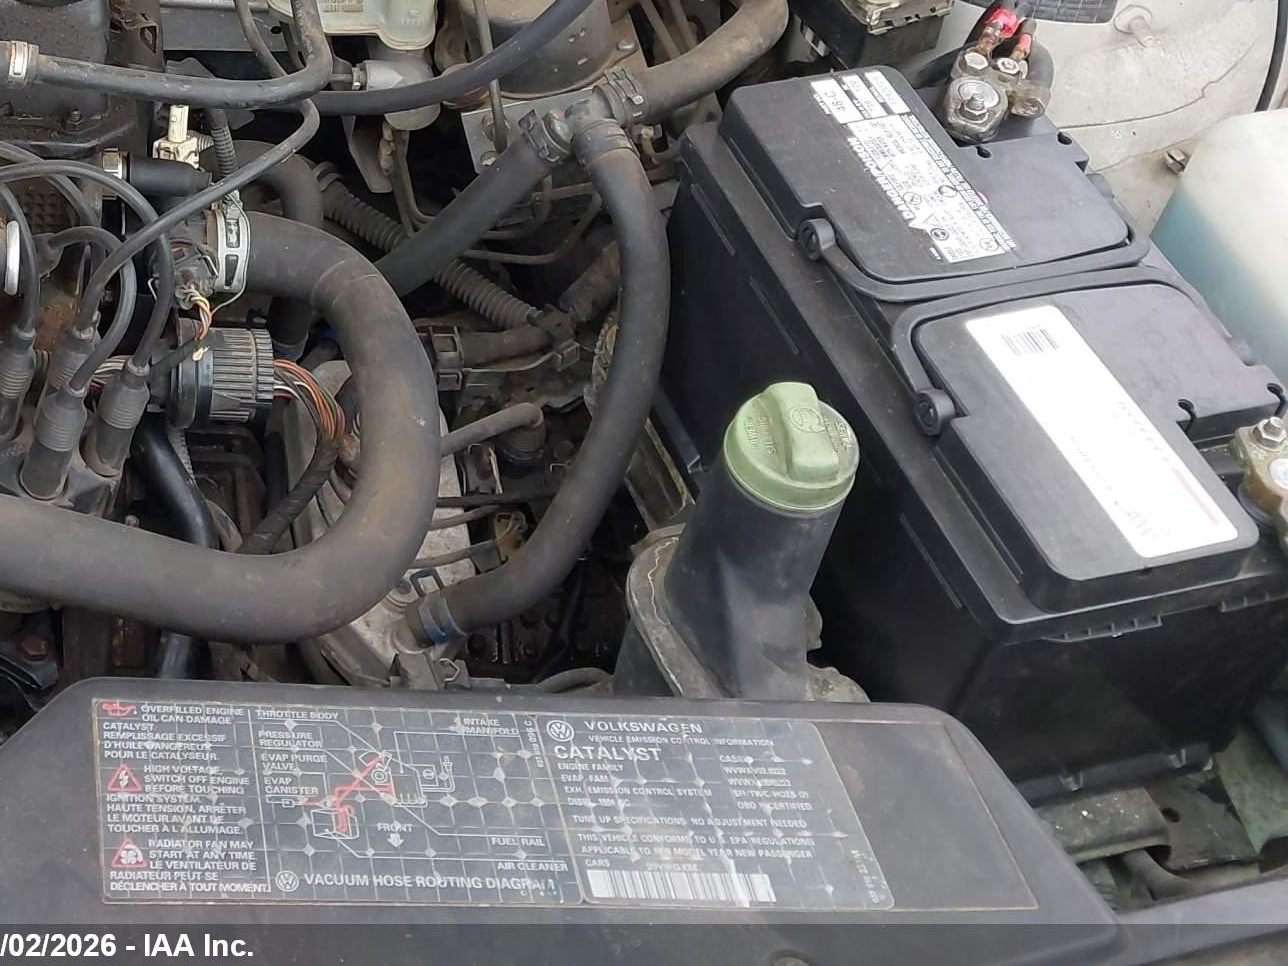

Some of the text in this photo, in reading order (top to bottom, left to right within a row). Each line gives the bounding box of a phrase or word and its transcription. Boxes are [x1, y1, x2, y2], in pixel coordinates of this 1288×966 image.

[141, 705, 244, 715] OVERFILLED ENGINE
[255, 710, 308, 719] THROTTLE
[162, 715, 184, 723] CAN
[185, 716, 232, 724] DAMAGE
[464, 718, 500, 726] INTAKE
[103, 722, 154, 731] CATALYST
[464, 727, 519, 735] MANIFOLD
[584, 721, 703, 733] VOLKSWAGEN
[103, 732, 226, 742] REMPLISSAGE EXCESSIF
[258, 731, 313, 740] PRESSURE
[588, 735, 624, 743] VEHICLE
[626, 736, 668, 744] EMISSION
[260, 739, 323, 748] REGULATOR
[104, 751, 134, 759] POUR
[136, 751, 148, 759] LE
[554, 746, 661, 761] CATALYST
[262, 754, 328, 763] EVAP PURGE
[144, 765, 169, 773] HIGH
[263, 762, 296, 771] VALVE
[144, 775, 249, 785] SWITCH OFF ENGINE
[264, 777, 292, 785] EVAP
[145, 785, 244, 794] BEFORE TOUCHING
[265, 786, 319, 795] CANISTER
[633, 787, 674, 796] CONTROL
[107, 794, 154, 802] IGNITION
[107, 804, 143, 812] HAUTE
[199, 803, 246, 815] ARRÊTER
[108, 814, 120, 822] LE
[122, 814, 167, 823] MOTEUR
[171, 815, 208, 824] AVANT
[599, 816, 611, 824] UP
[691, 818, 704, 826] NO
[108, 824, 159, 833] TOUCHER
[148, 839, 254, 849] RADIATOR FAN MAY
[492, 837, 546, 847] FUEL RAIL
[578, 834, 598, 842] THIS
[600, 834, 638, 842] VEHICLE
[730, 837, 747, 845] EPA
[149, 850, 183, 859] START
[186, 851, 199, 859] AT
[203, 850, 225, 859] ANY
[708, 849, 733, 857] YEAR
[735, 850, 756, 858] NEW
[758, 850, 813, 858] PASSENGER
[150, 861, 256, 870] LE VENTILATEUR DE
[497, 862, 569, 872] AIR CLEANER
[585, 859, 610, 867] CARS
[110, 871, 219, 881] RADIATEUR PEUT SE
[110, 881, 177, 891] DÉCLENCHER
[191, 883, 216, 891] TOUT
[304, 874, 369, 886] VACUUM
[373, 875, 412, 887] HOSE
[416, 875, 482, 889] ROUTING
